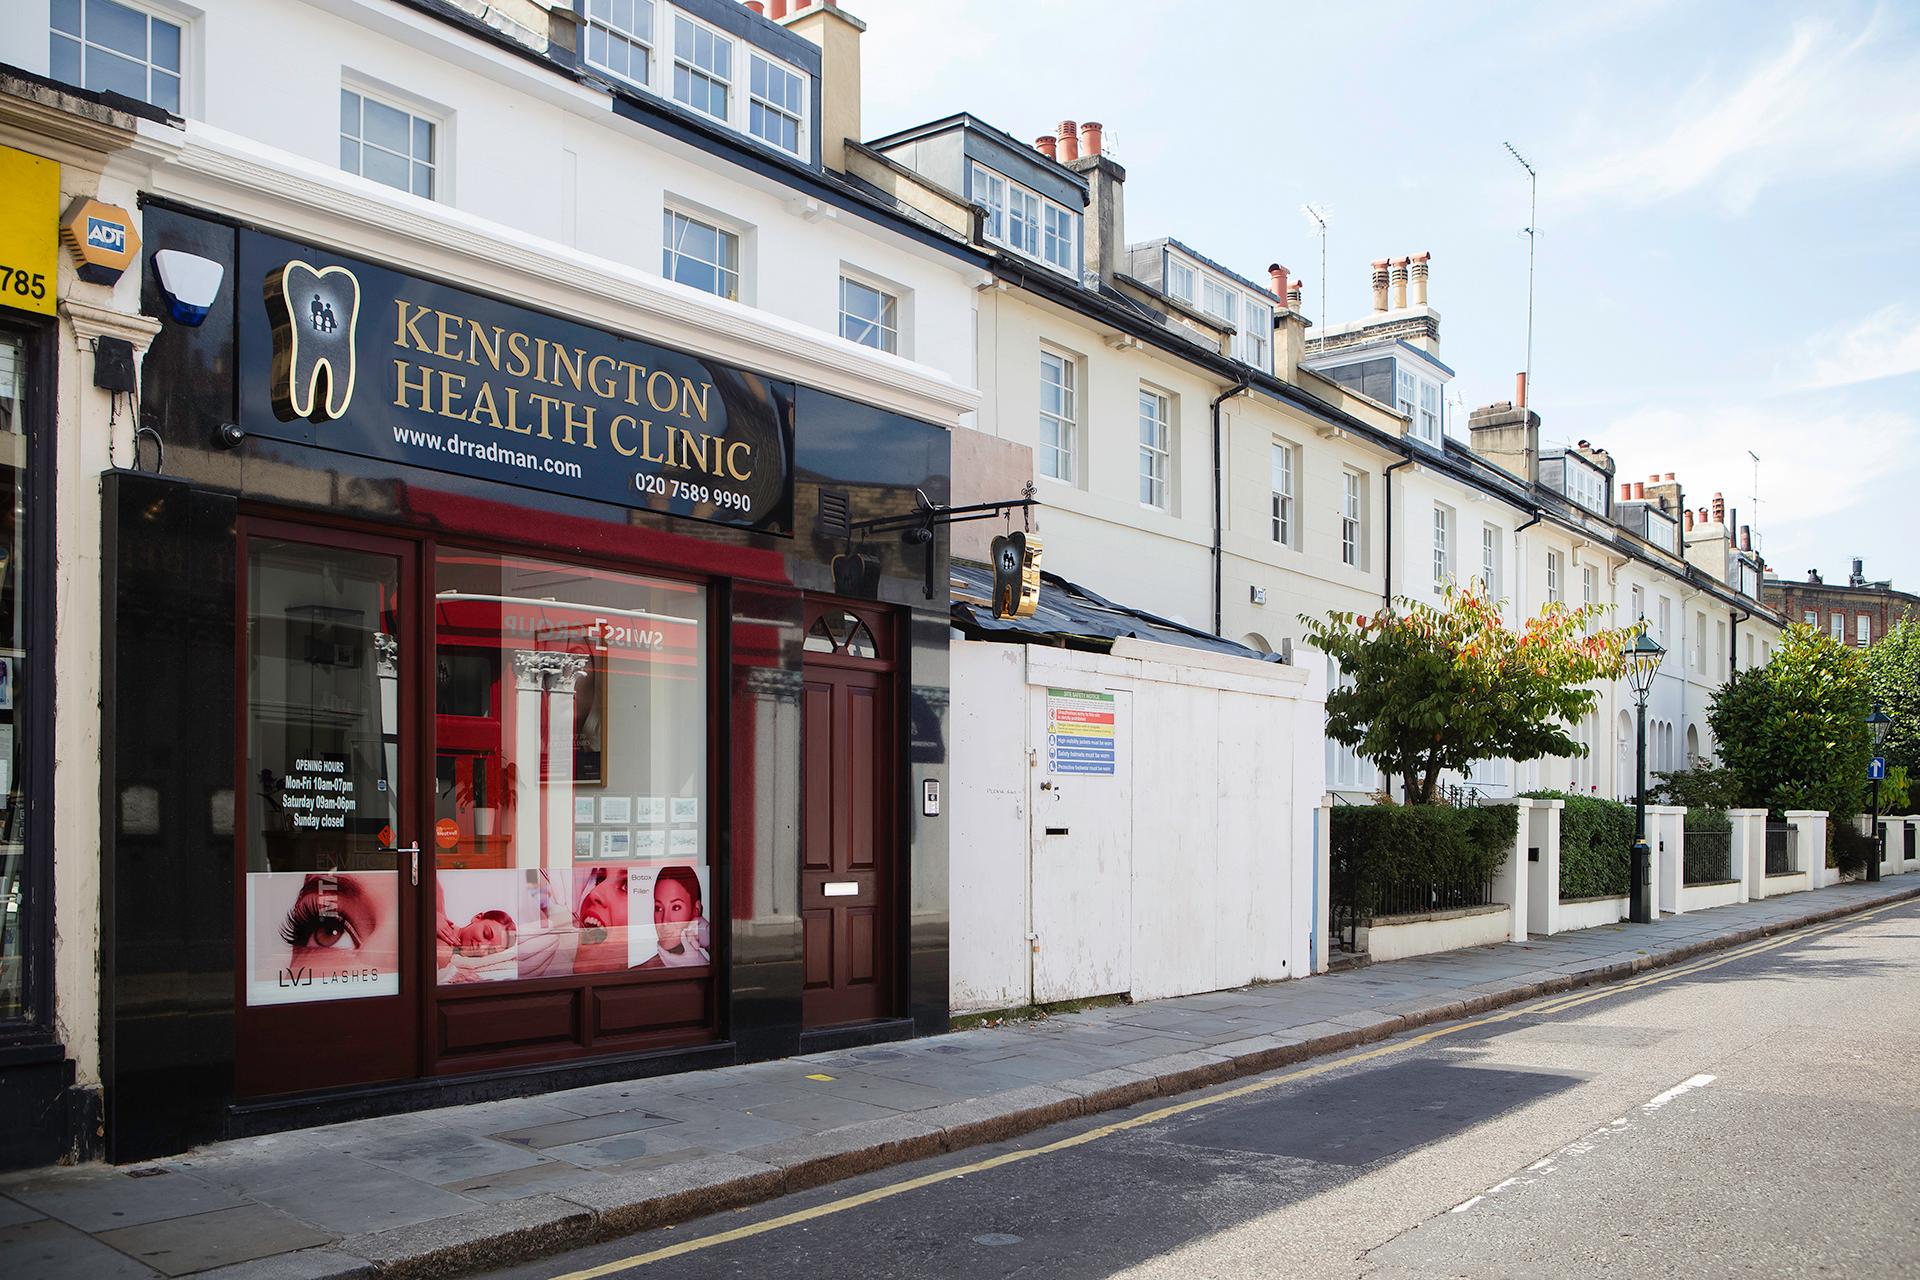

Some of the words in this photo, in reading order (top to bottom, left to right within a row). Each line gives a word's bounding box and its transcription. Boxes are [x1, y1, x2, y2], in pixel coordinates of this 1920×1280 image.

[88, 224, 124, 247] ADT
[0, 265, 45, 300] 785
[392, 299, 711, 423] KENSINGTON
[392, 359, 598, 450] HEALTH
[609, 415, 752, 481] CLINIC
[392, 427, 582, 479] www.drradman.com
[635, 472, 667, 496] 020
[670, 480, 710, 503] 7589
[713, 487, 752, 512] 9990
[295, 758, 323, 772] OPENING
[323, 760, 345, 773] HOURS
[285, 775, 312, 790] Mon-Fri
[313, 777, 353, 794] 10am-07pm
[282, 794, 315, 812] Saturday
[315, 795, 356, 813] 09am-06pm
[293, 812, 320, 830] Sunday
[321, 814, 345, 828] closed
[631, 873, 653, 881] Botox
[322, 968, 379, 985] LASHES
